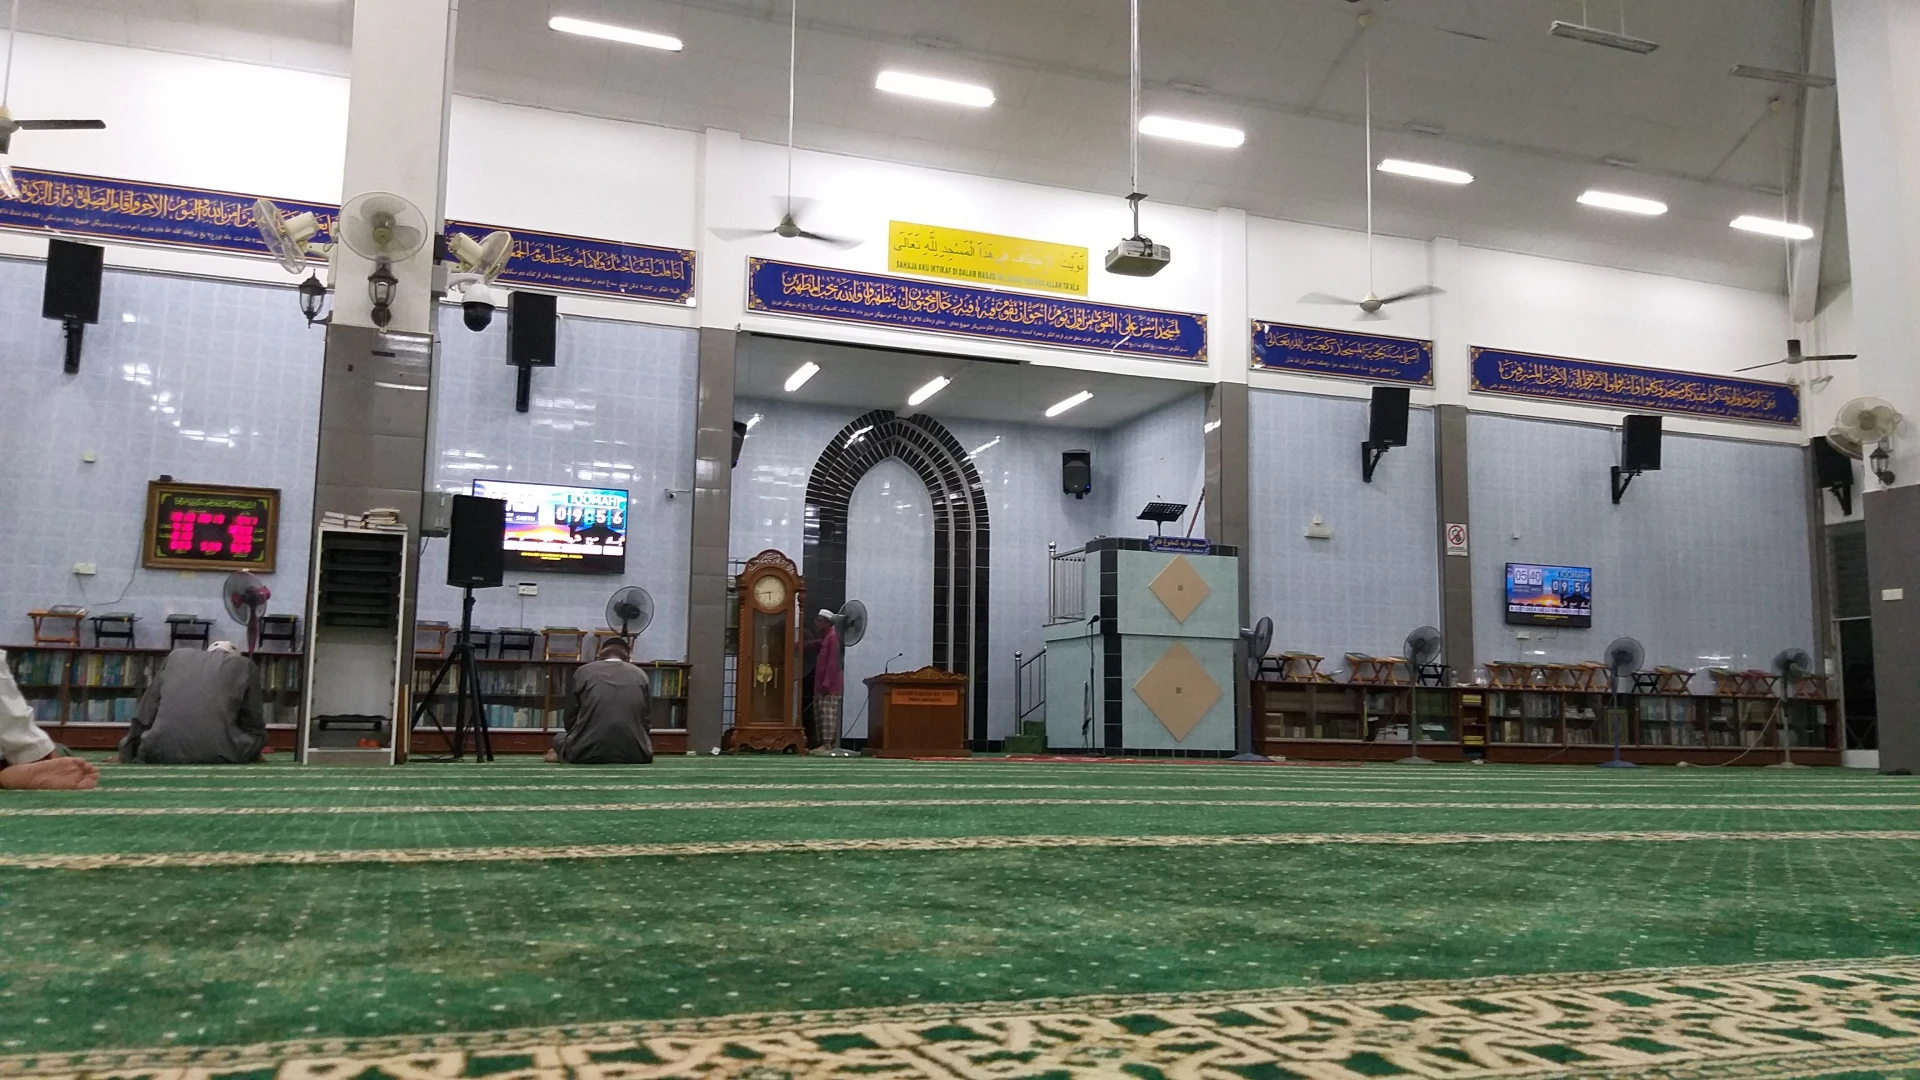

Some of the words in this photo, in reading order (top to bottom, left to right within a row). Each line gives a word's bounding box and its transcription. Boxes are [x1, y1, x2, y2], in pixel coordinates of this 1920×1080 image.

[896, 260, 917, 270] SAHAJA
[918, 263, 930, 272] AKU
[952, 267, 959, 275] DI
[959, 268, 977, 277] DALAM
